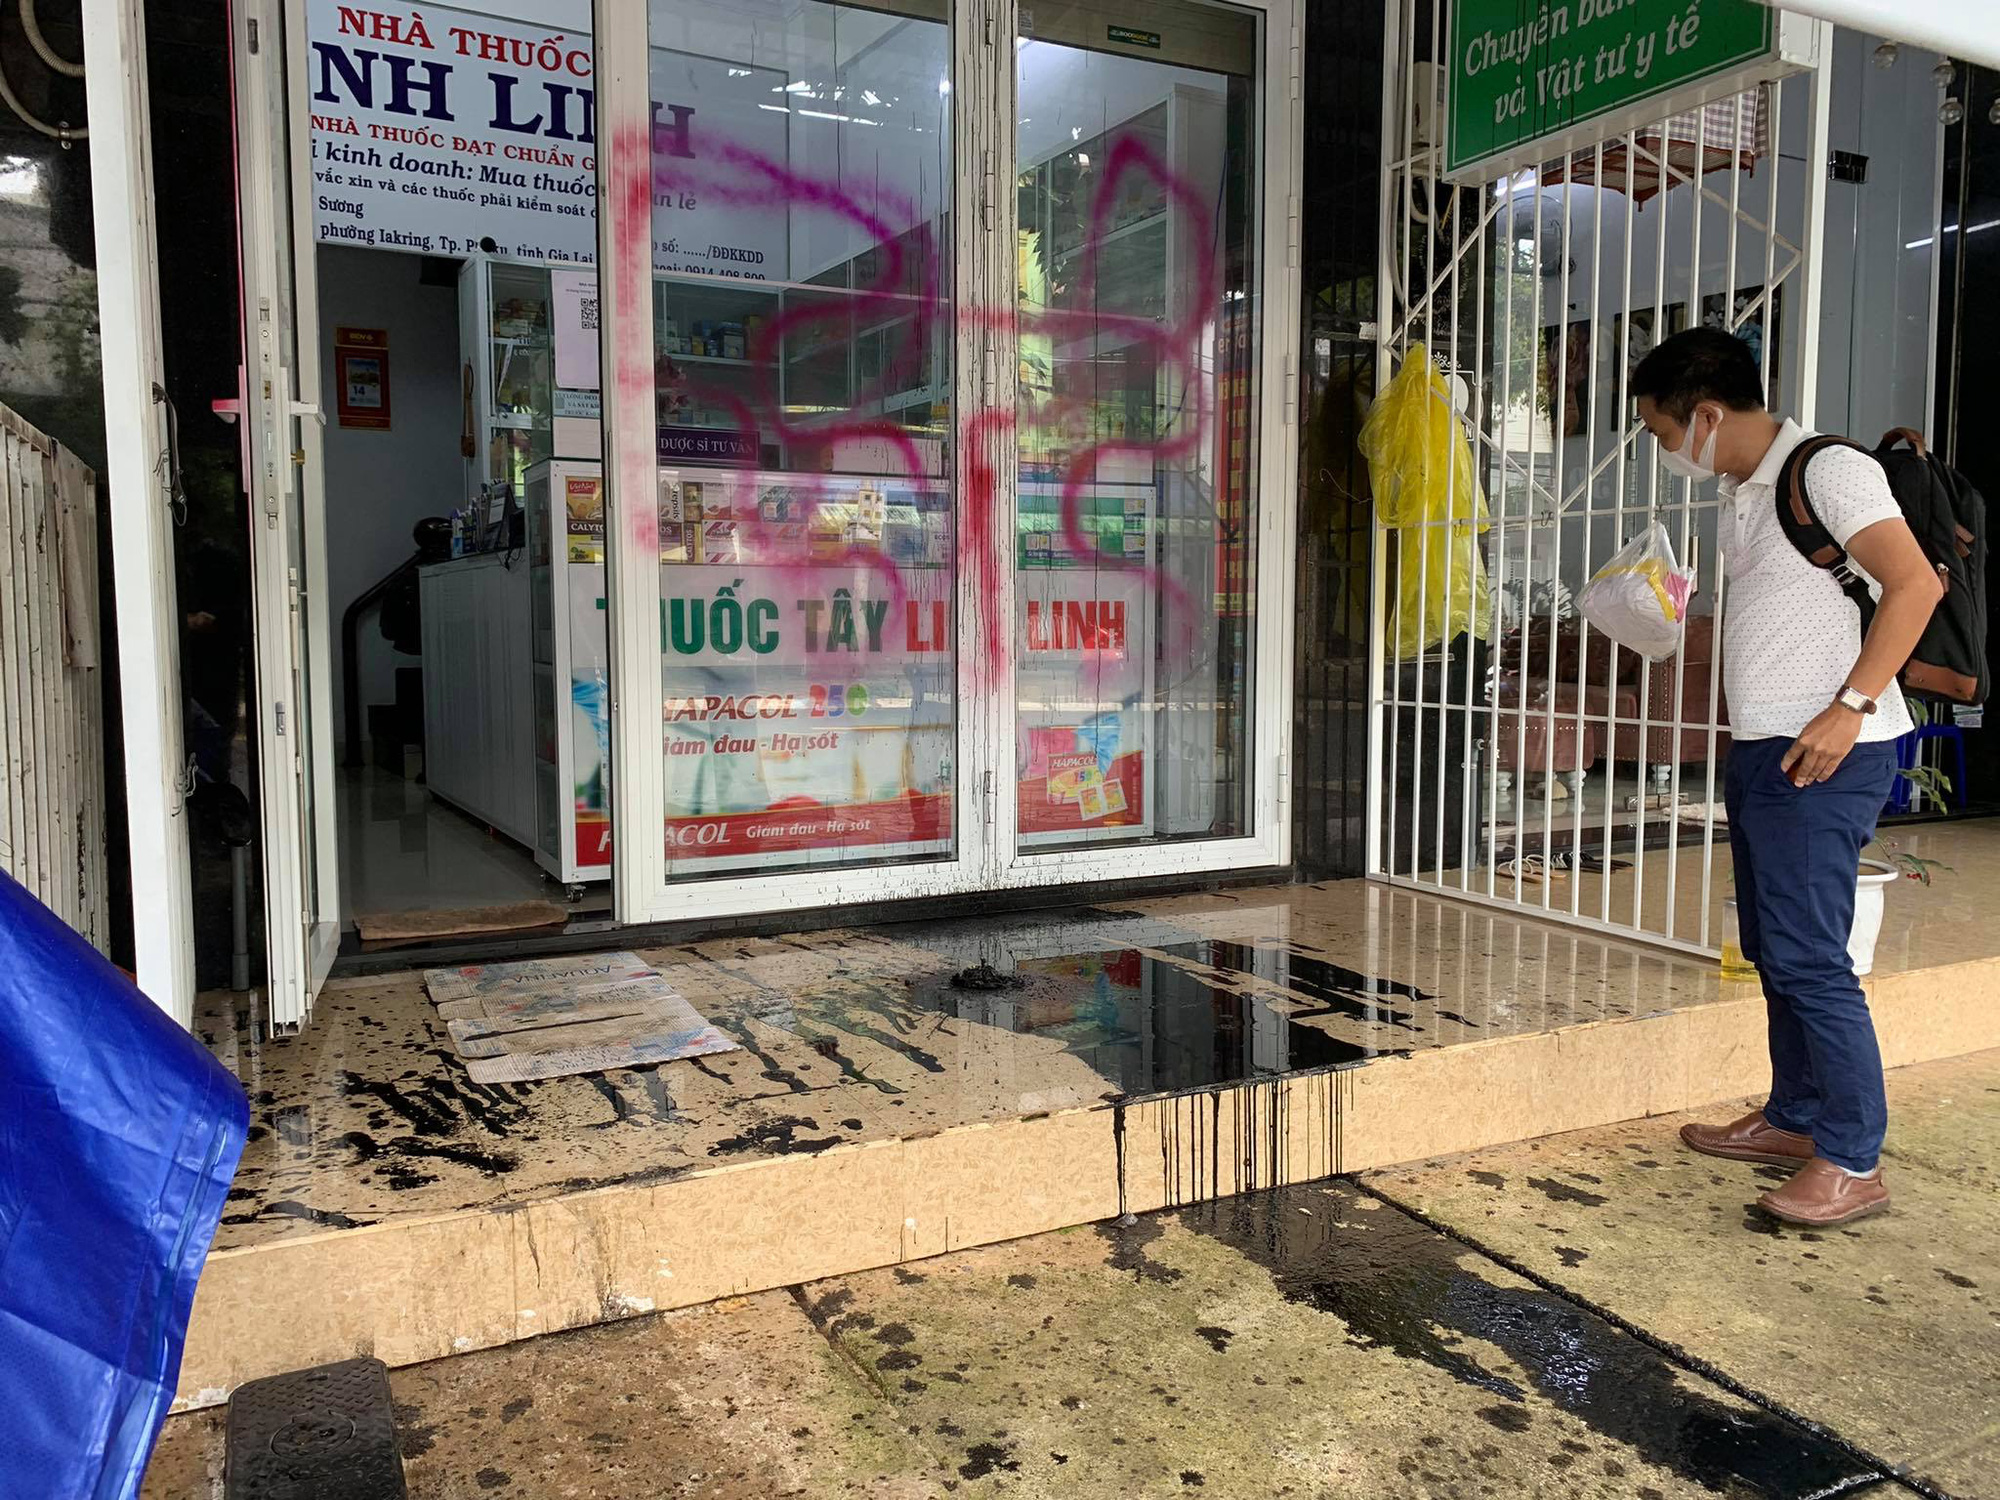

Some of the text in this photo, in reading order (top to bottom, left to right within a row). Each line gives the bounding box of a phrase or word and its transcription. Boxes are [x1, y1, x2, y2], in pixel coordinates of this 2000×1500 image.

[337, 6, 592, 77] NHÀ THUỐC
[1465, 4, 1569, 76] Chuyên
[1494, 1, 1700, 124] và Vật tư y tế
[311, 115, 360, 136] NHÀ
[368, 126, 445, 148] THUỐC
[452, 136, 496, 157] ĐẠT
[504, 143, 575, 168] CHUẨN
[315, 167, 343, 184] vắc
[348, 175, 373, 189] xin
[378, 179, 396, 192] và
[402, 182, 428, 196] các
[433, 184, 476, 202] thuốc
[480, 192, 512, 207] phải
[517, 195, 552, 213] kiểm
[557, 203, 586, 217] soát
[326, 142, 382, 168] kinh
[389, 152, 473, 180] doanh:
[479, 165, 527, 188] Mua
[534, 173, 595, 197] thuốc
[319, 196, 364, 219] Sương
[662, 237, 679, 254] số:
[320, 222, 375, 245] phường
[379, 228, 434, 251] Iakring,
[439, 235, 461, 254] Tp.
[517, 243, 544, 259] tỉnh
[660, 437, 694, 453] DƯỢC
[711, 439, 728, 453] TƯ
[797, 587, 889, 653] TÂY
[906, 600, 945, 652] LI
[1027, 601, 1125, 650] LINH
[664, 733, 706, 757] iảm
[713, 732, 756, 755] đau
[771, 733, 802, 755] Hạ
[806, 730, 839, 752] sốt
[789, 823, 816, 836] đau
